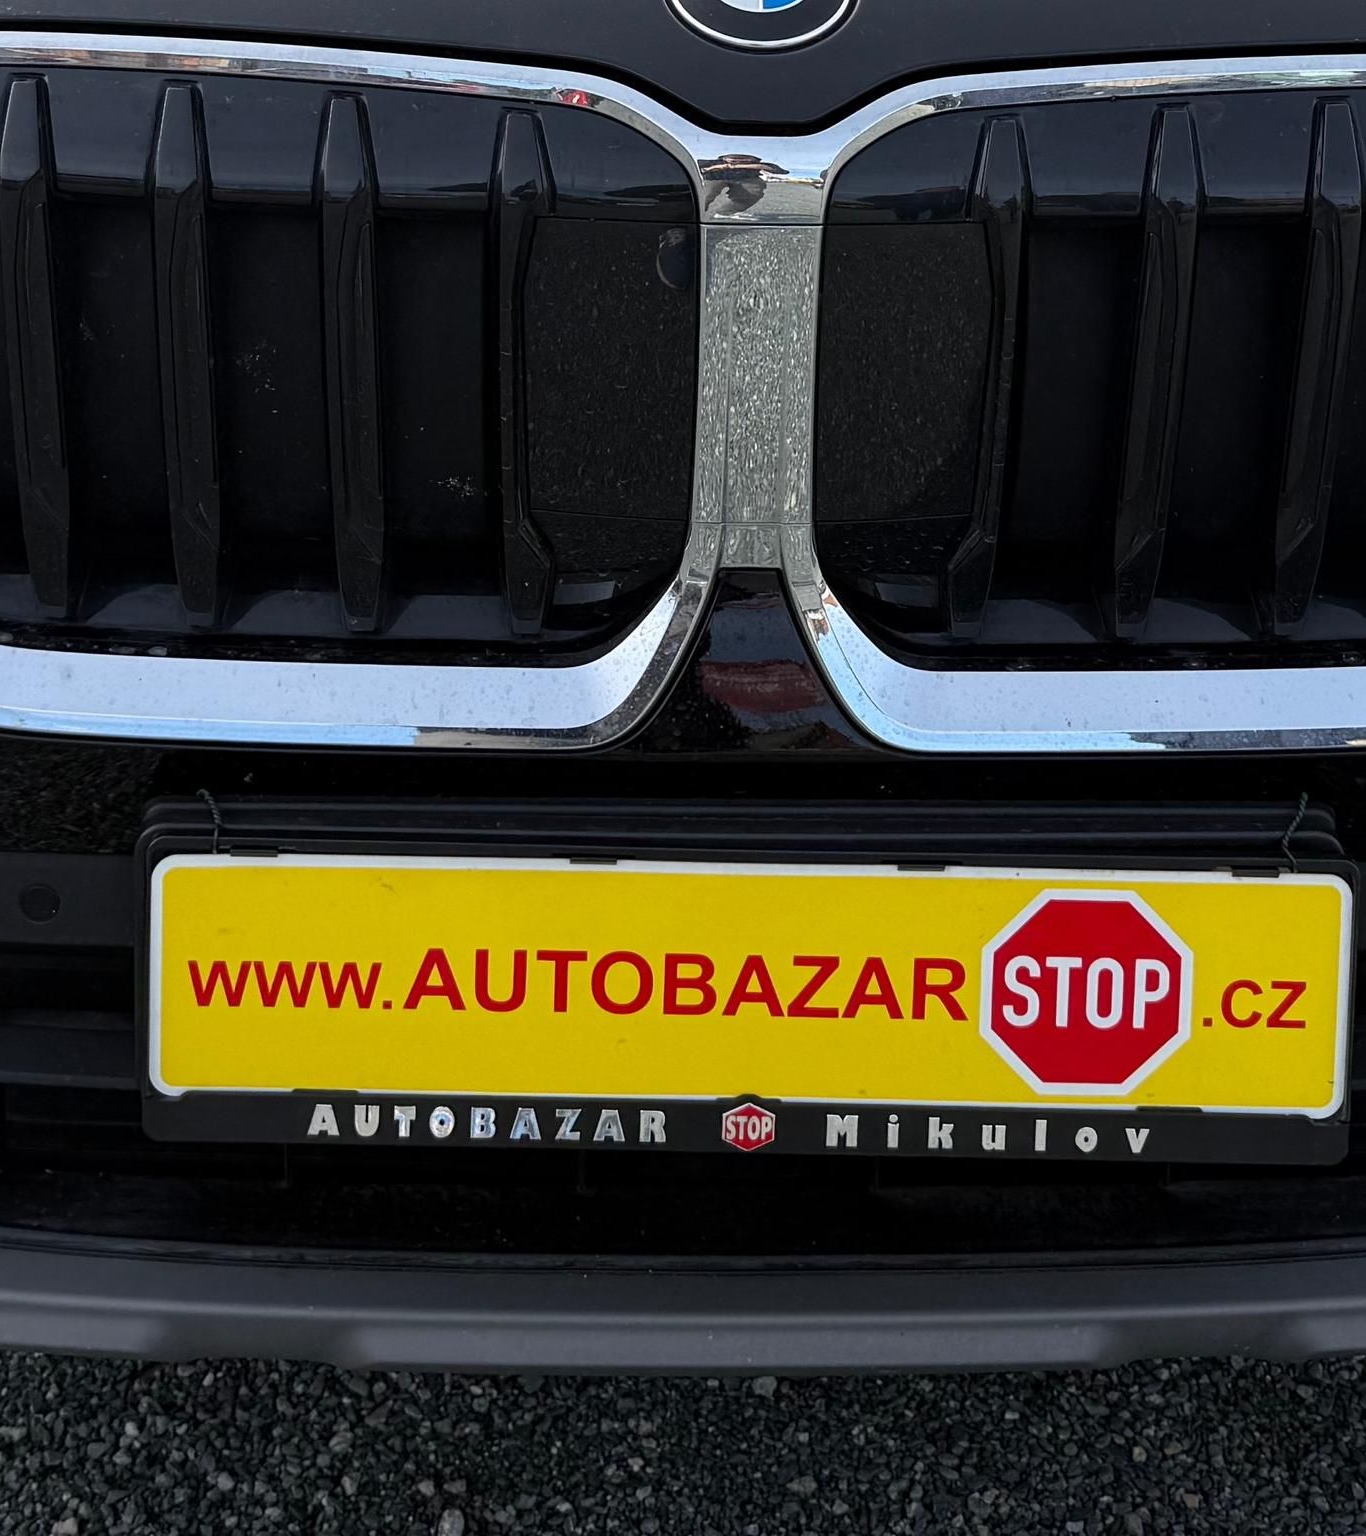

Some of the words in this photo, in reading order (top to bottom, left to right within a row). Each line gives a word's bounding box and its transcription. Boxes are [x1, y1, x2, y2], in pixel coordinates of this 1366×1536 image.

[1001, 953, 1172, 1030] STOP
[306, 1102, 668, 1144] AUTOBAZAR
[725, 1114, 773, 1142] STOP
[825, 1112, 1151, 1155] Mikulov
